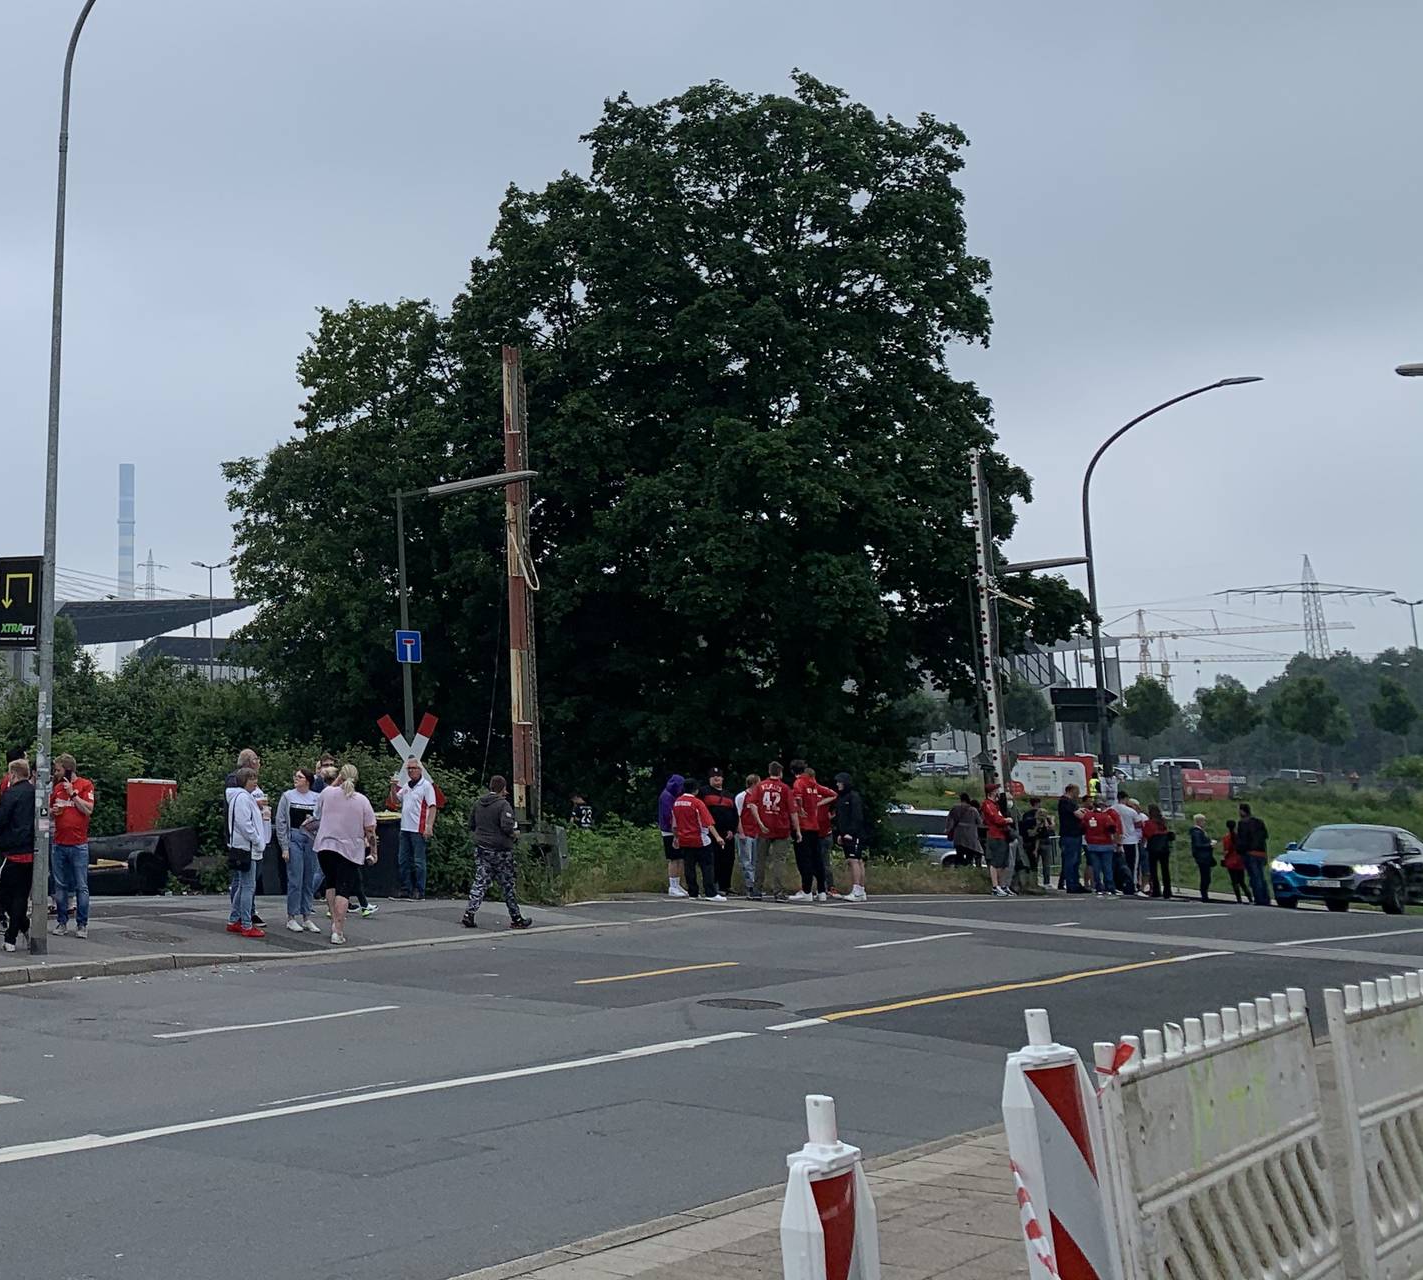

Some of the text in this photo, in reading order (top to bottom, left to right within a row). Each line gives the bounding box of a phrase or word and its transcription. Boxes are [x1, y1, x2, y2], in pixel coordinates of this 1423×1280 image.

[1, 623, 36, 635] XTRAFIT
[762, 791, 782, 812] 42
[581, 809, 592, 823] 23
